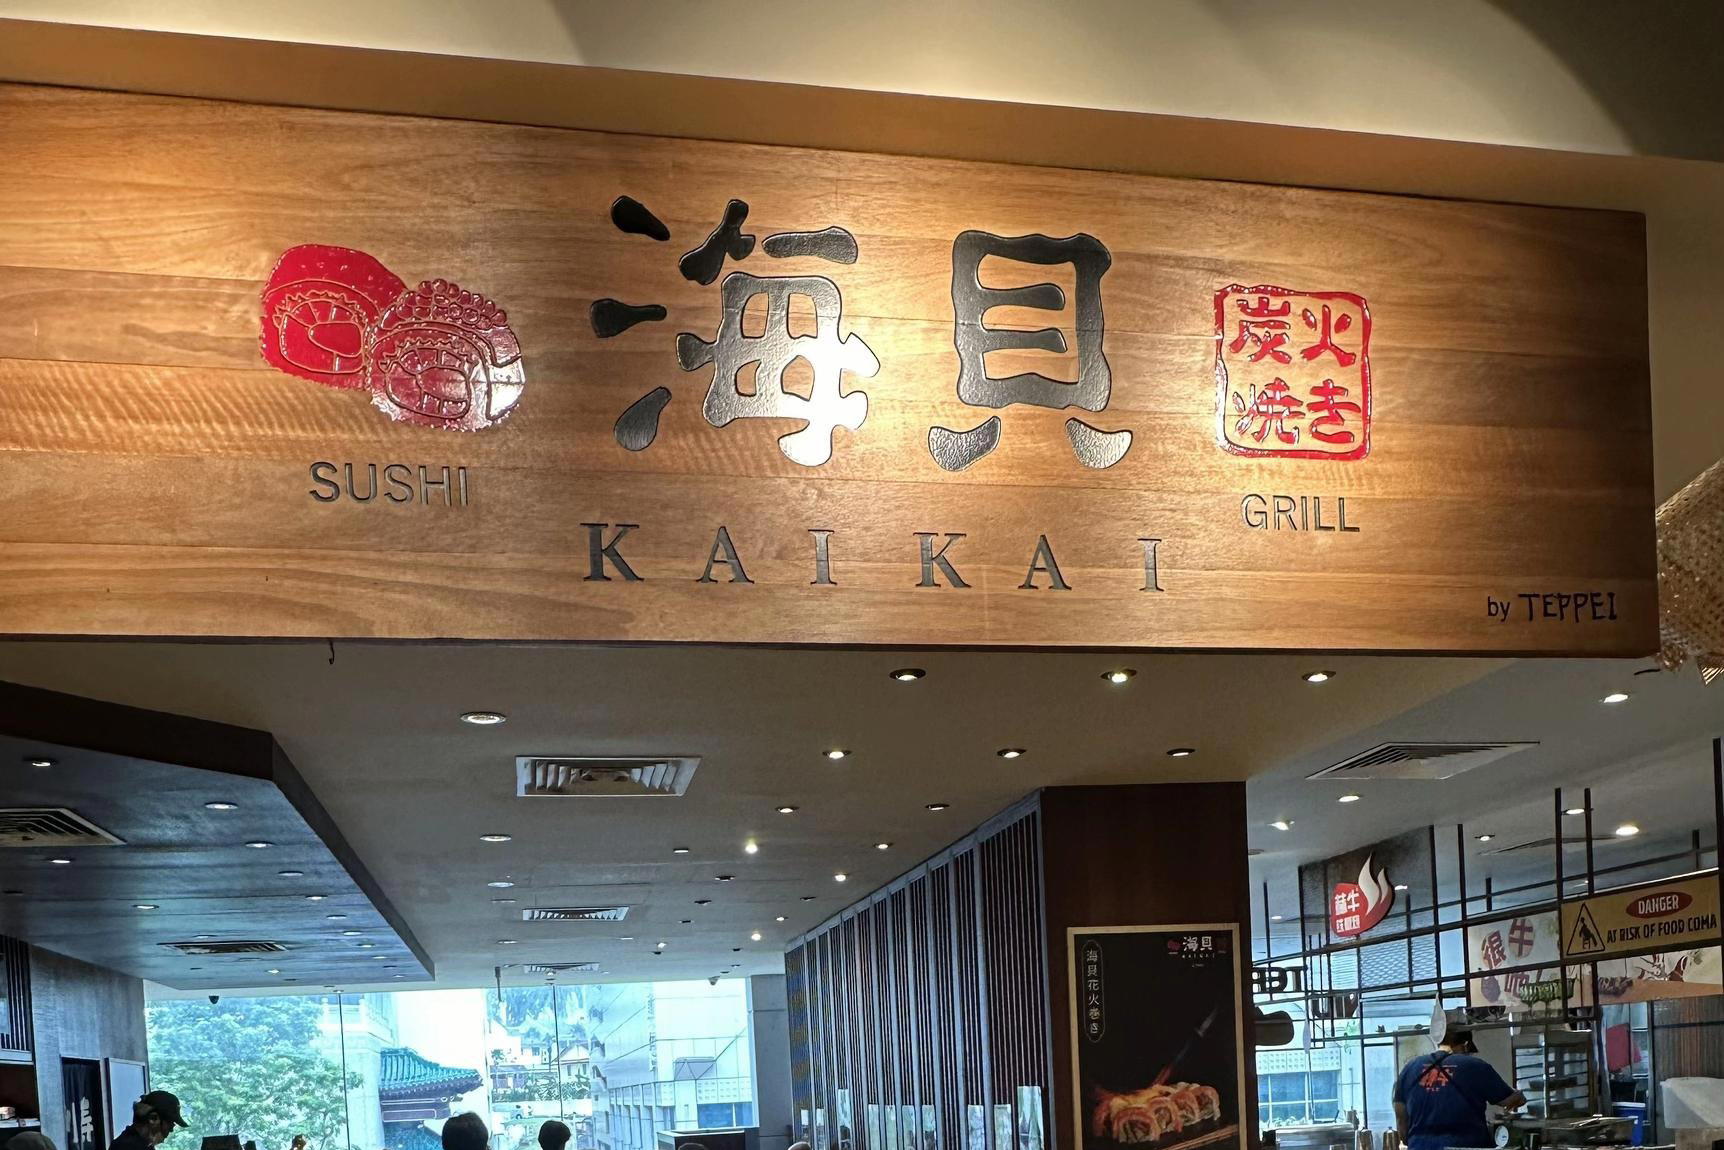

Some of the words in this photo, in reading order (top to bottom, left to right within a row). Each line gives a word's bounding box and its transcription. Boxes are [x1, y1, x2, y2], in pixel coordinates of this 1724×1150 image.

[591, 195, 1133, 471] 海貝
[309, 462, 469, 507] SUSHI
[1241, 493, 1361, 532] GRILL
[1487, 595, 1511, 622] by
[1518, 591, 1618, 622] TEPPEI
[1638, 894, 1680, 916] DANGER
[1607, 928, 1618, 944] AT
[1620, 926, 1641, 942] RISK
[1643, 923, 1656, 939] OF
[1658, 919, 1685, 936] FOOD
[1687, 913, 1718, 933] COMA
